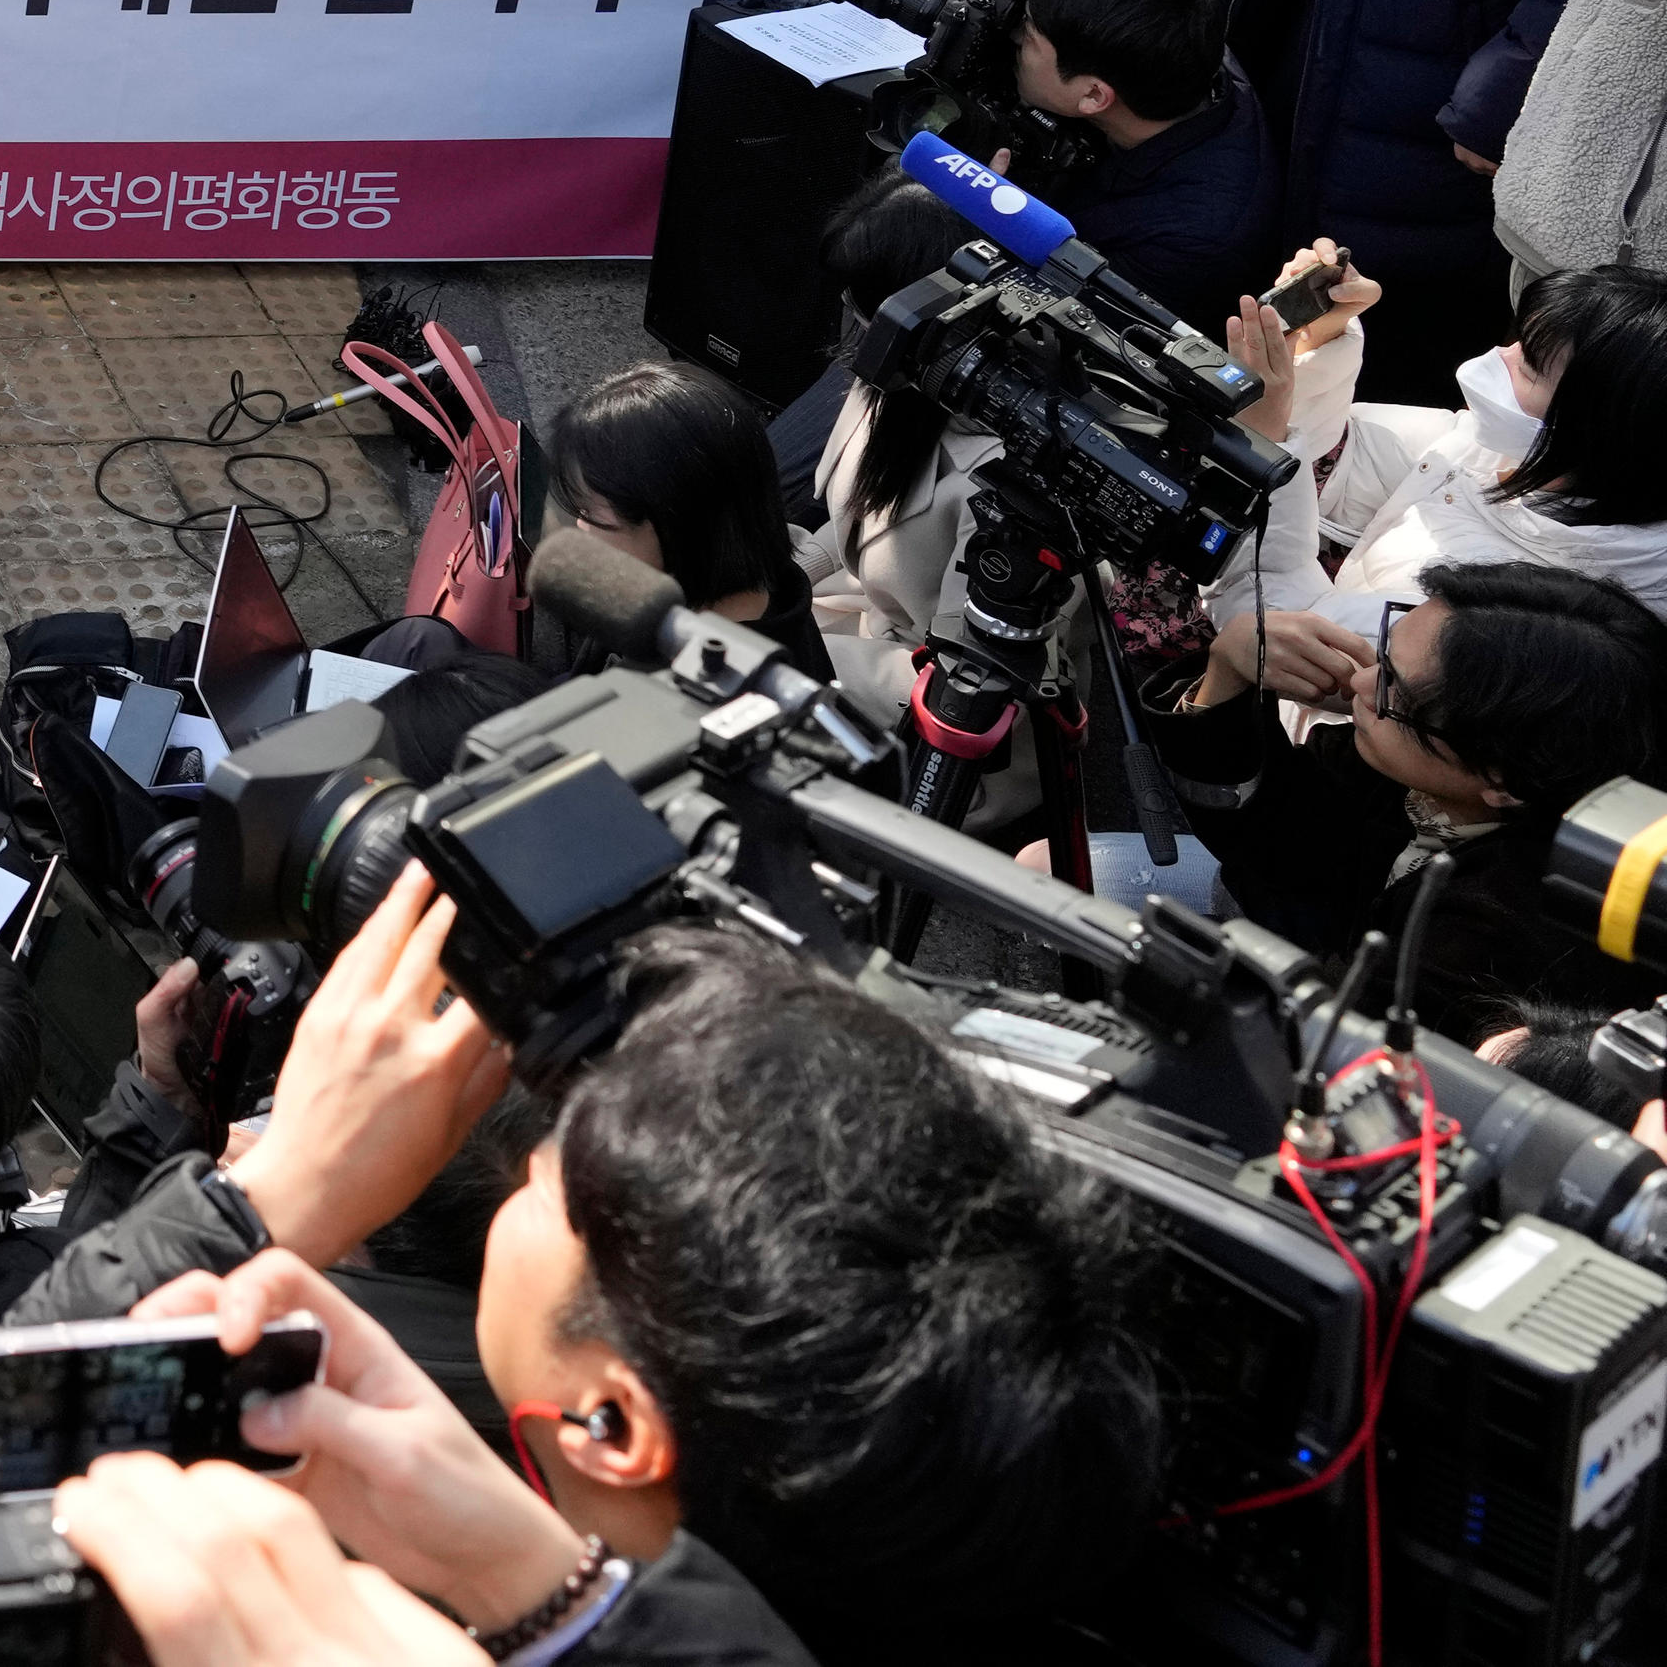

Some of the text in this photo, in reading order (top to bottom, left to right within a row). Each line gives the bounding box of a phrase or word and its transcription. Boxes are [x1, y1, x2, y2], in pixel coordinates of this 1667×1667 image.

[1030, 108, 1054, 128] Nikon
[934, 153, 997, 189] AFP
[1138, 469, 1179, 498] SONY
[911, 751, 942, 815] sachtle
